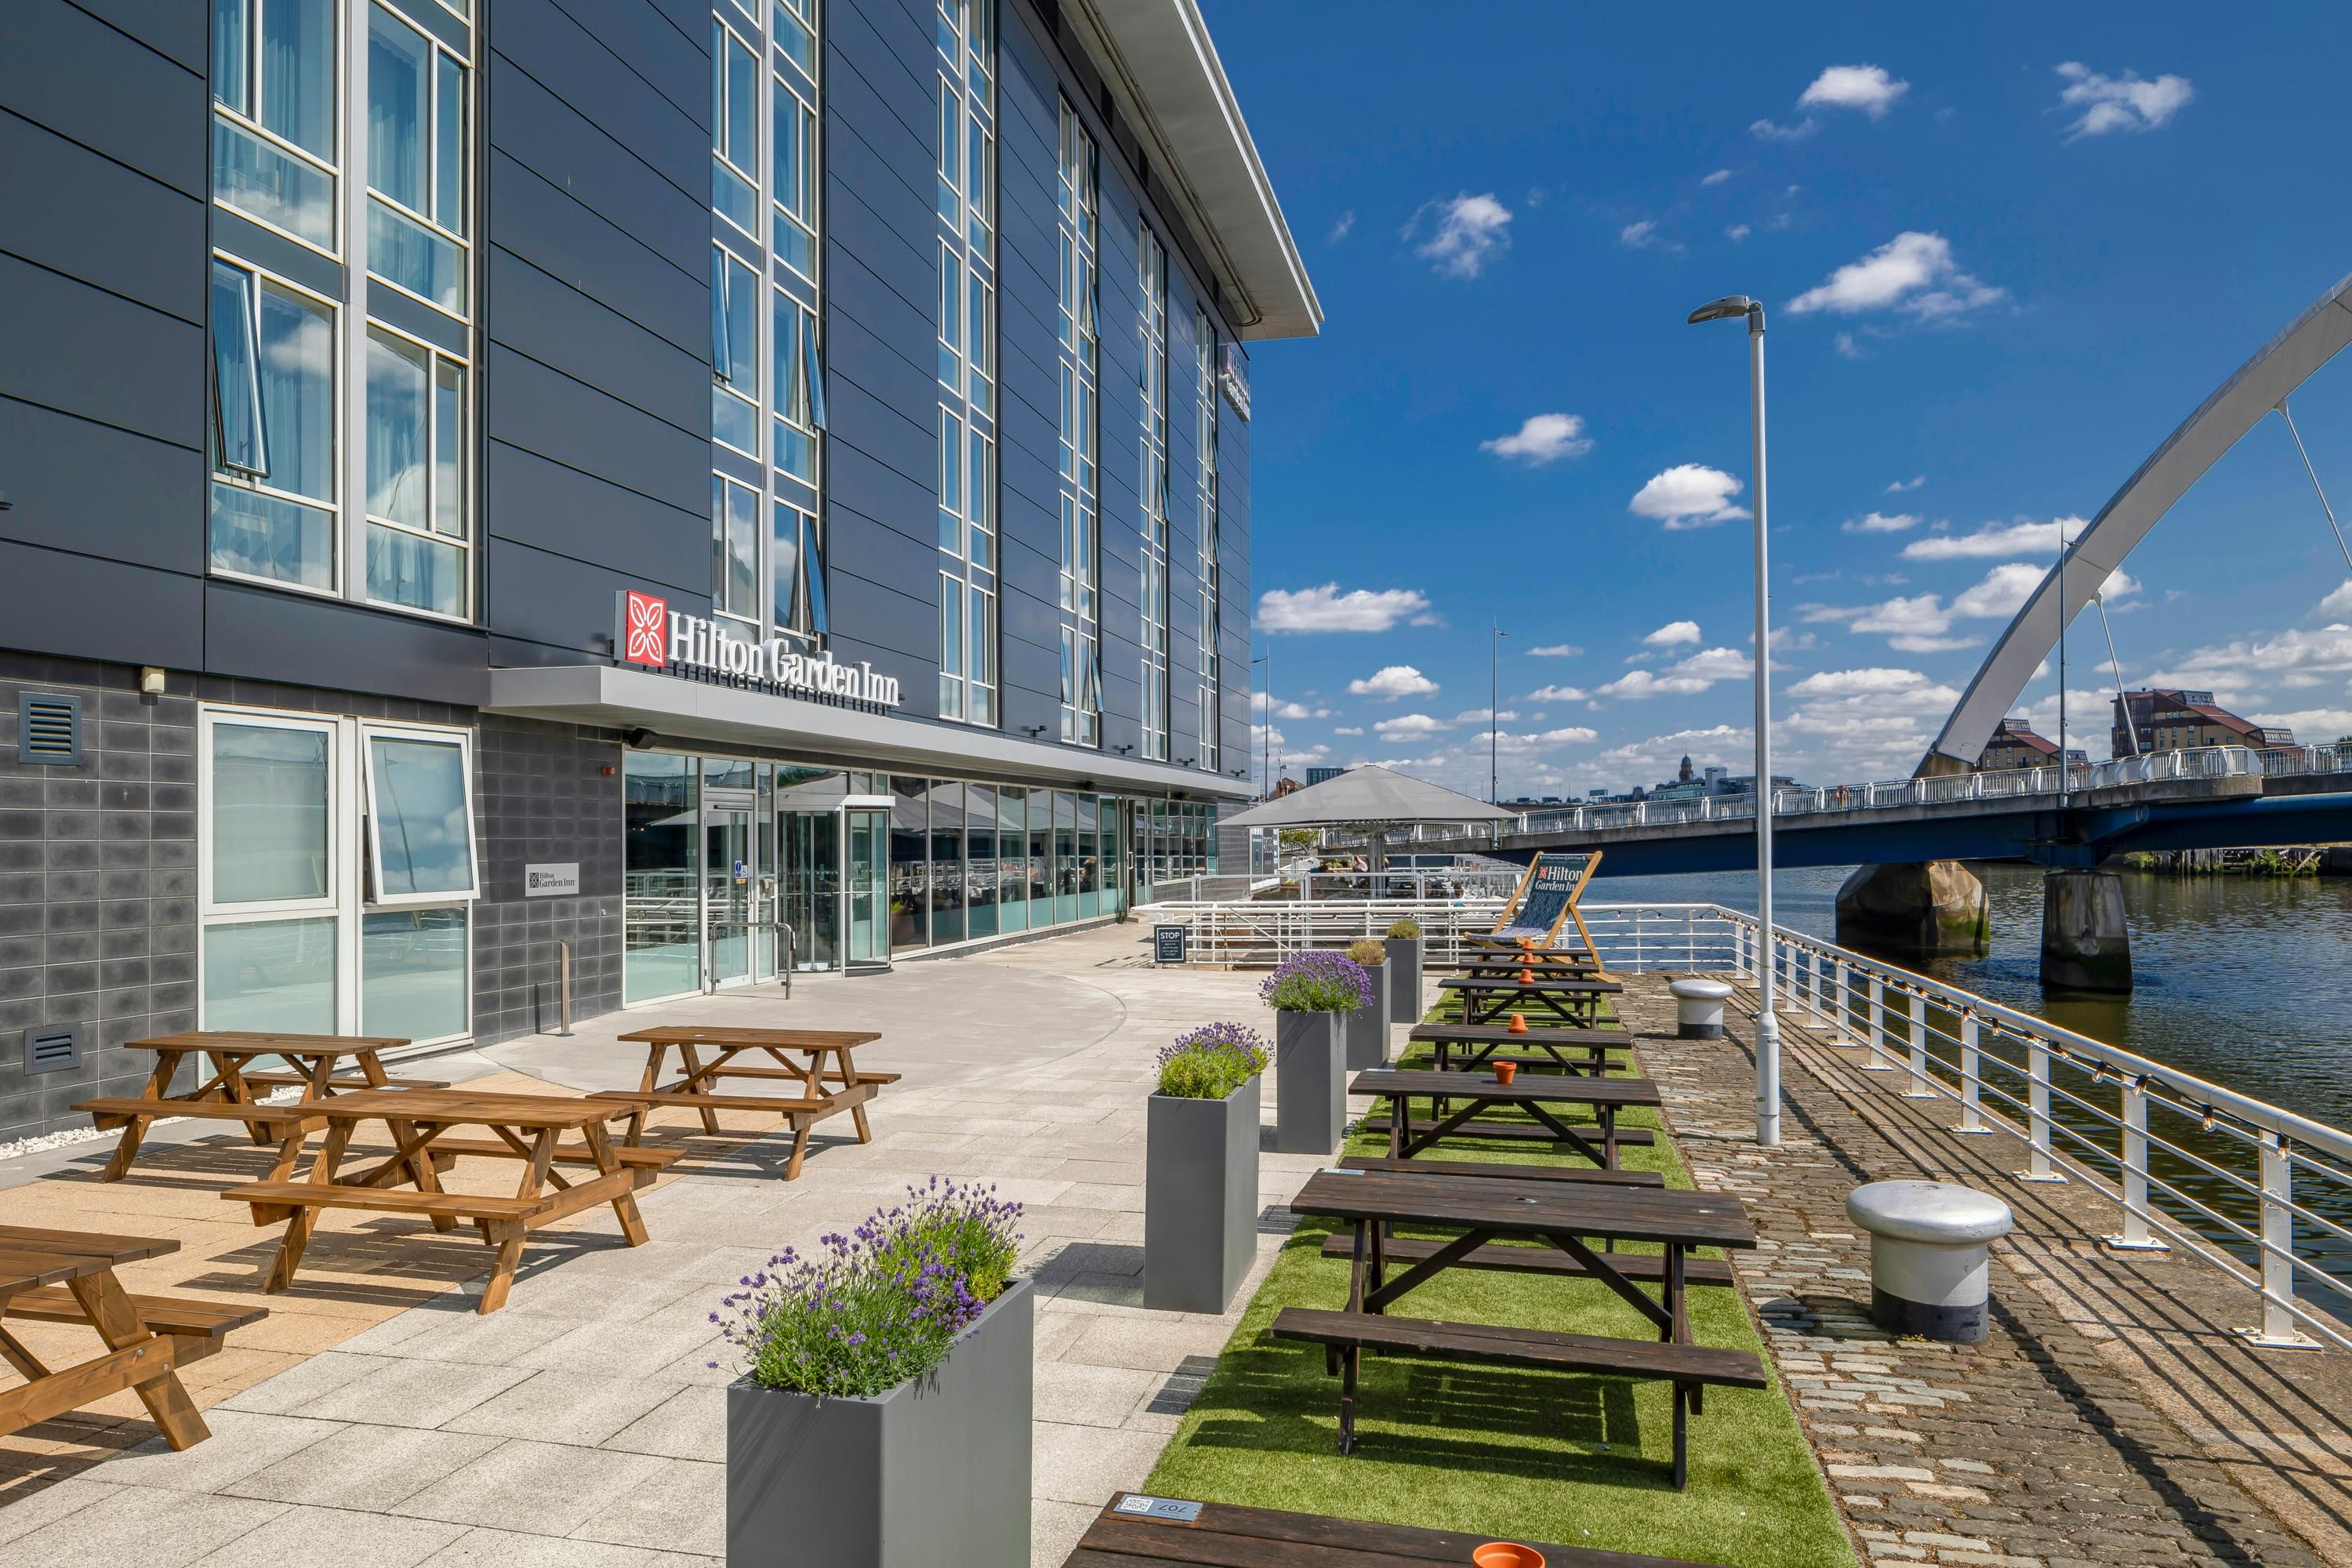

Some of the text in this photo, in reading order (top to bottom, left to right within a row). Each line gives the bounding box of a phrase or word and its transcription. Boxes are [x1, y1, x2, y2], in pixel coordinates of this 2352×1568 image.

[668, 610, 900, 706] Hilton Garden Inn
[1547, 866, 1583, 881] Hilton
[539, 879, 564, 887] Garden
[1535, 880, 1577, 891] Garden In
[1158, 1504, 1188, 1513] 707
